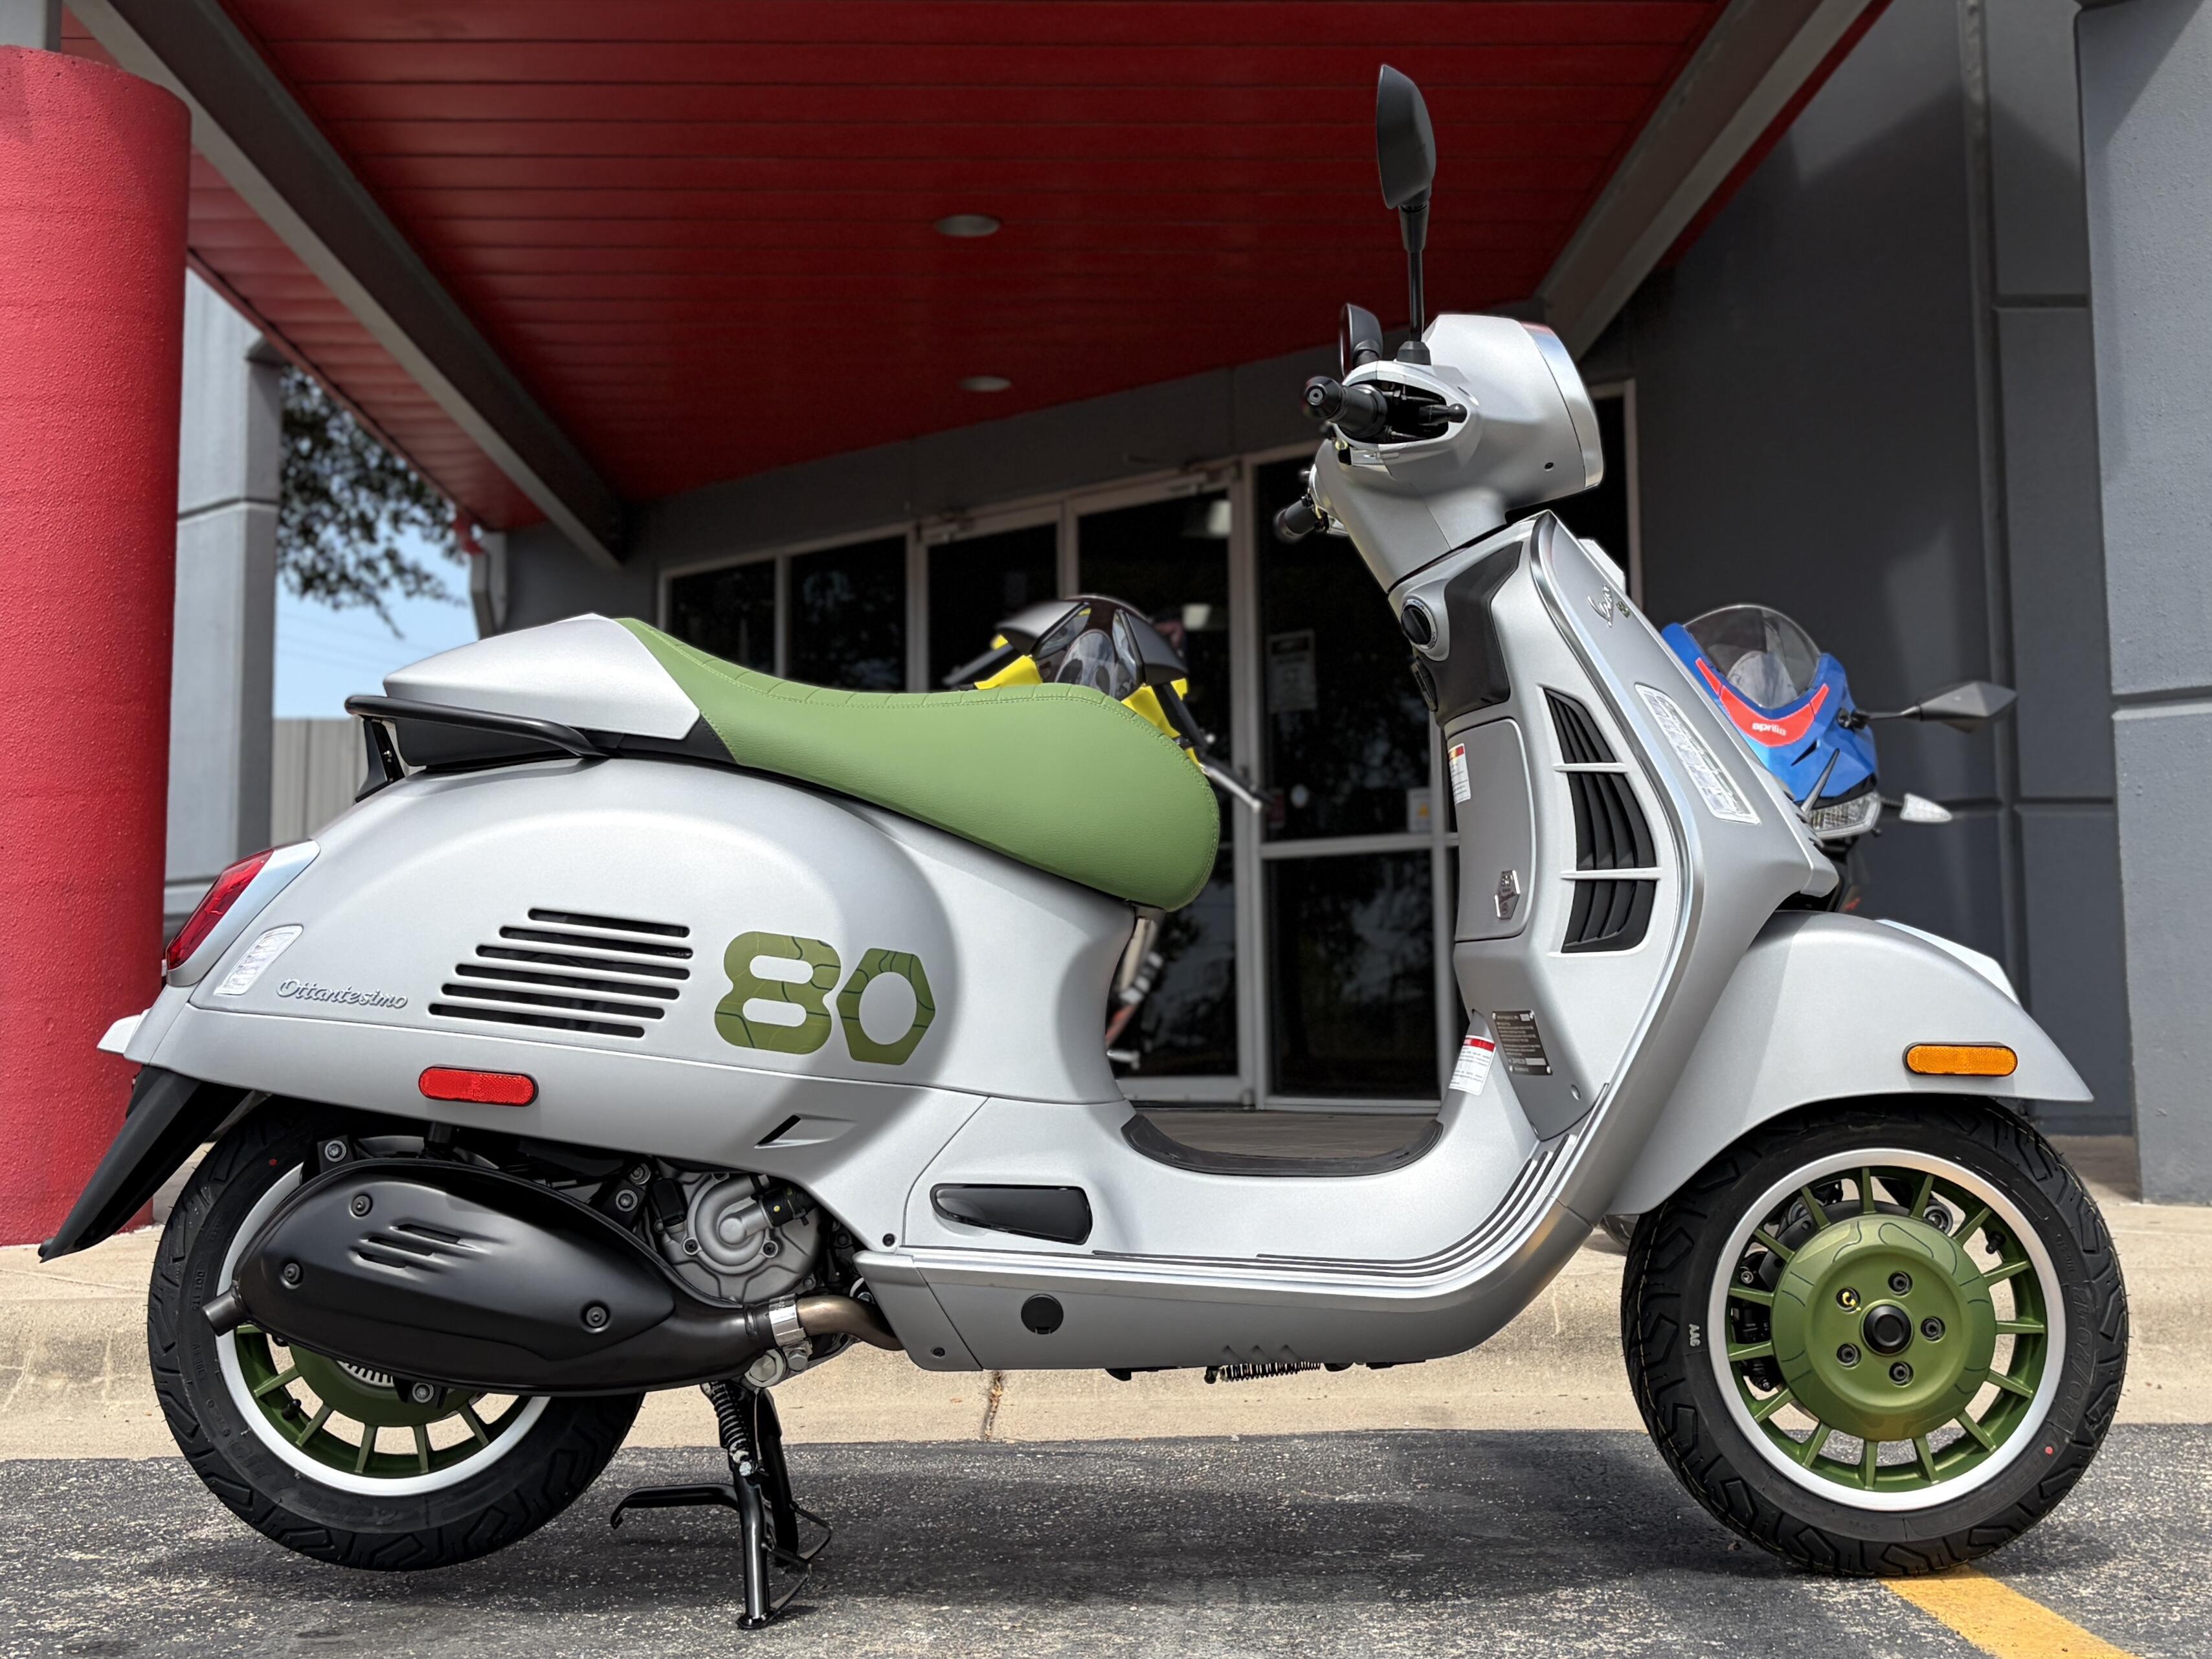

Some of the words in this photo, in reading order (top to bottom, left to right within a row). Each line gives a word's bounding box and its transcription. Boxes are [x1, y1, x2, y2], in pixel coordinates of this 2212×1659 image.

[1752, 722, 1786, 736] aprilia
[276, 979, 408, 1008] Ottantesimo
[715, 931, 936, 1065] 80
[196, 1271, 205, 1290] DOT
